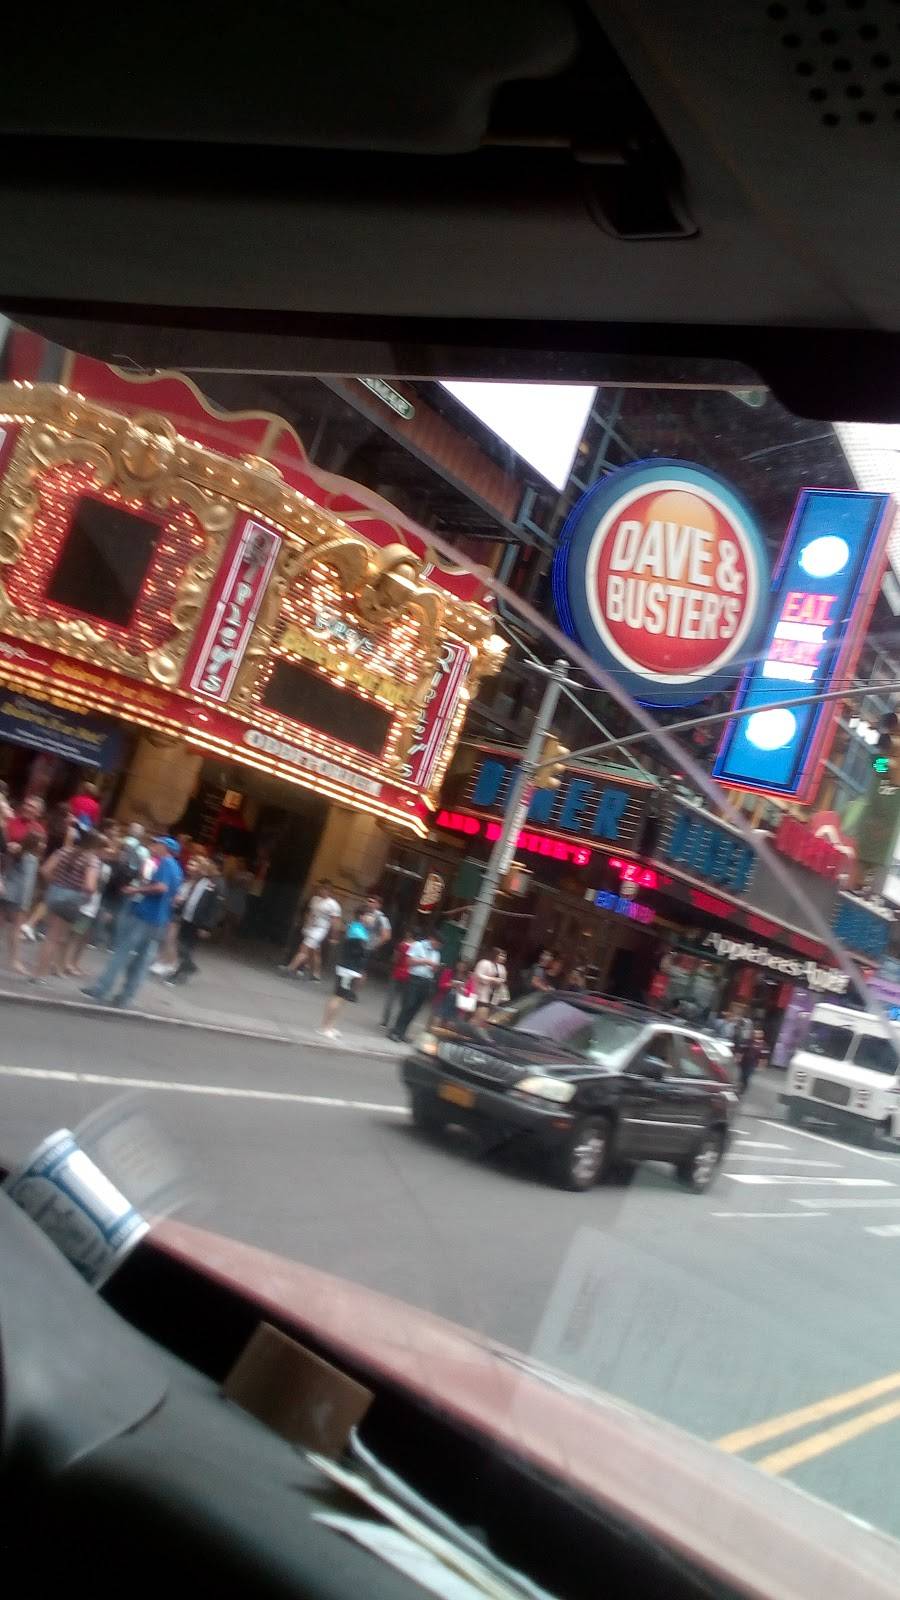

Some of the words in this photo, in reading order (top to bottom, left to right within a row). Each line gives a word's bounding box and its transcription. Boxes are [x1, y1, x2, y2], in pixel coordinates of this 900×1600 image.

[608, 519, 715, 588] DAVE
[715, 539, 746, 595] &
[605, 574, 742, 640] BUSTER'S
[781, 591, 838, 627] EAT
[435, 810, 481, 836] AND
[484, 818, 593, 866] BSTER'S
